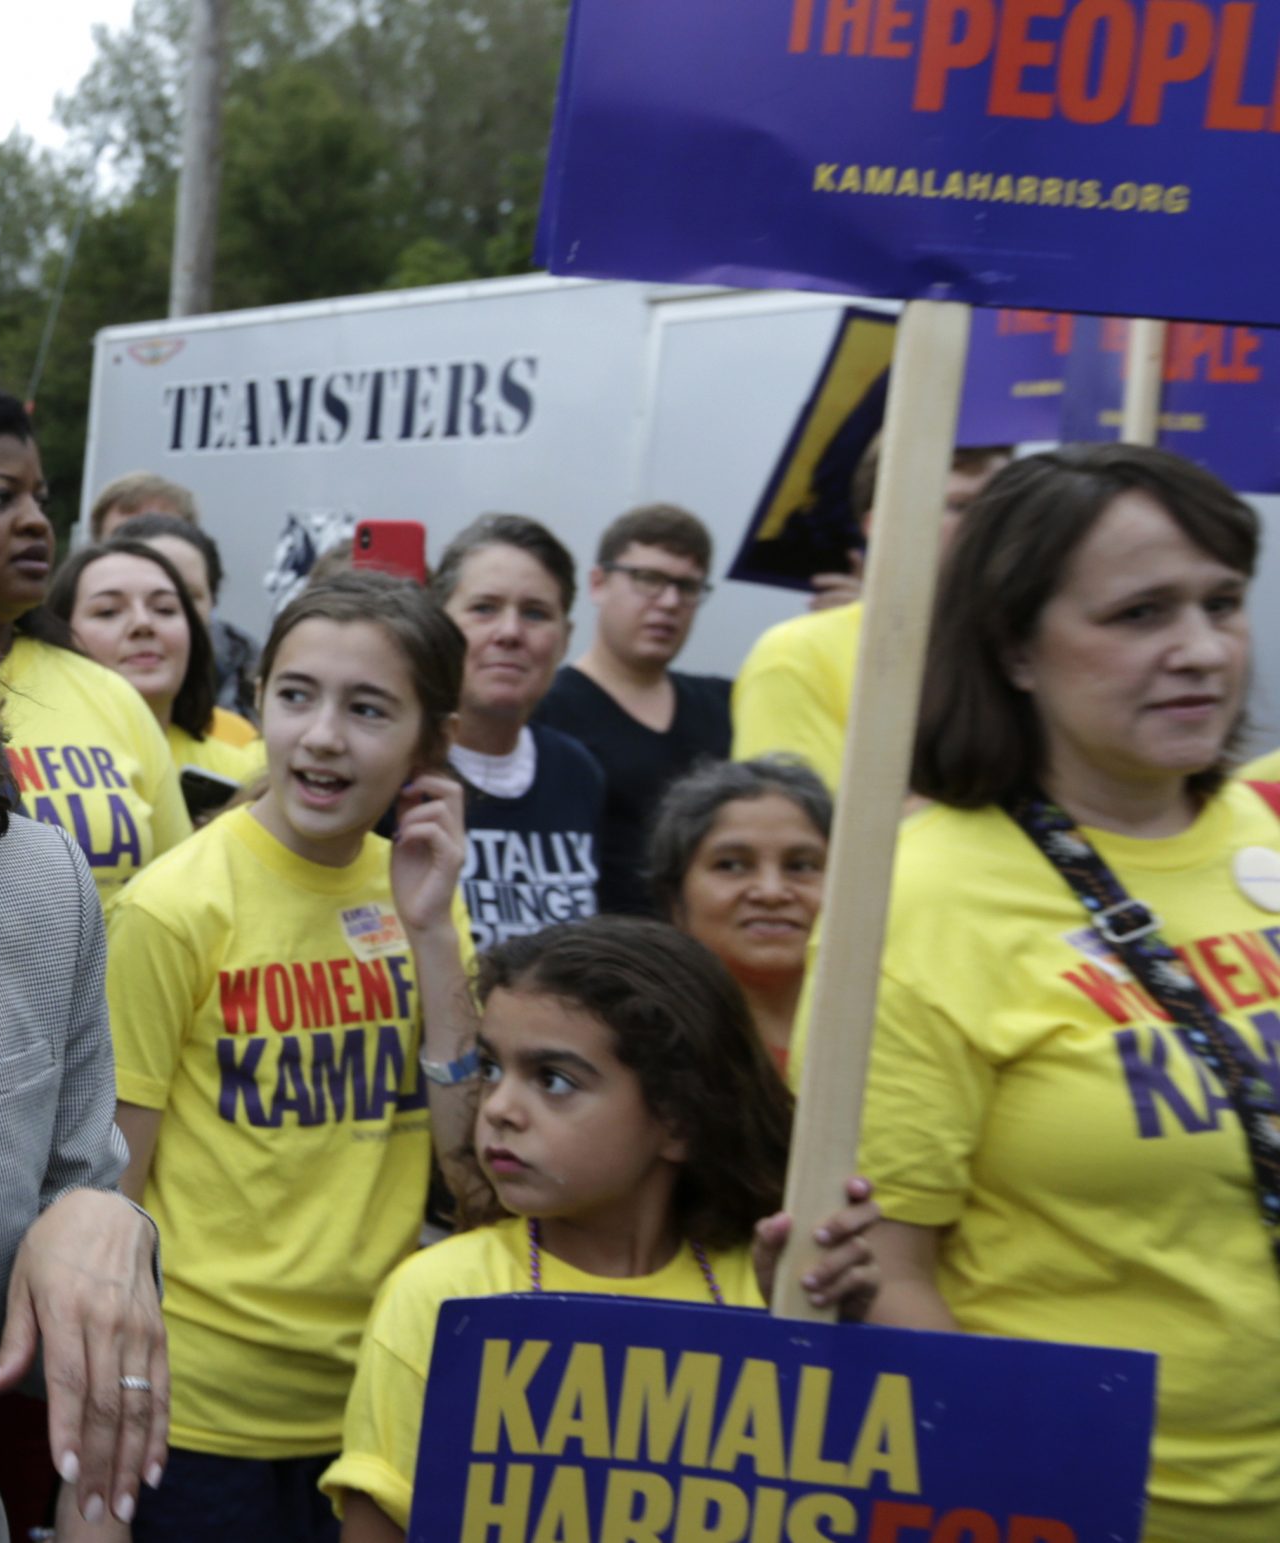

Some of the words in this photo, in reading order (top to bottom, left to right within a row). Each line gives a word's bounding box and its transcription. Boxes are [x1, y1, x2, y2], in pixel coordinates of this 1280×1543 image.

[912, 0, 1280, 132] PEOPL
[812, 161, 1191, 214] KAMALAHARRIS.ORG
[165, 356, 538, 451] TEAMSTERS
[471, 1338, 921, 1494] KAMALA
